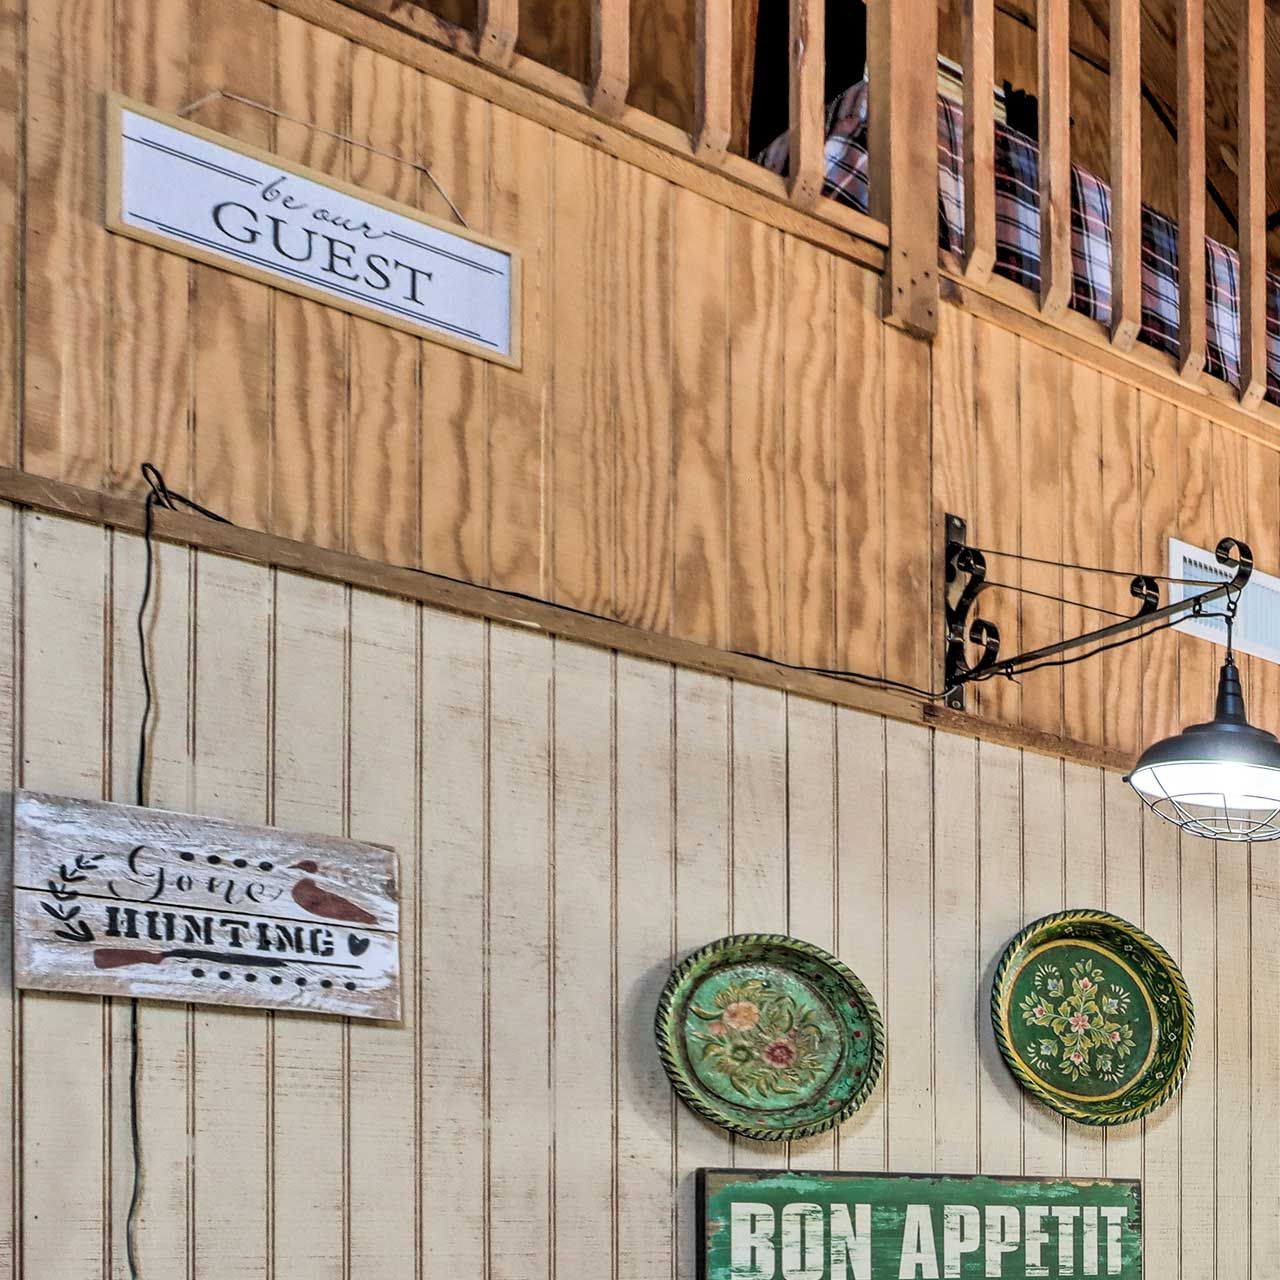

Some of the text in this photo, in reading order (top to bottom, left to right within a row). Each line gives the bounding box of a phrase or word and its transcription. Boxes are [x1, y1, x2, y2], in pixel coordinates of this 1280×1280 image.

[262, 175, 384, 240] be our
[211, 200, 433, 306] GUEST
[107, 845, 284, 904] Gone
[105, 905, 335, 957] HUNTING
[898, 1204, 1129, 1280] APPETIT
